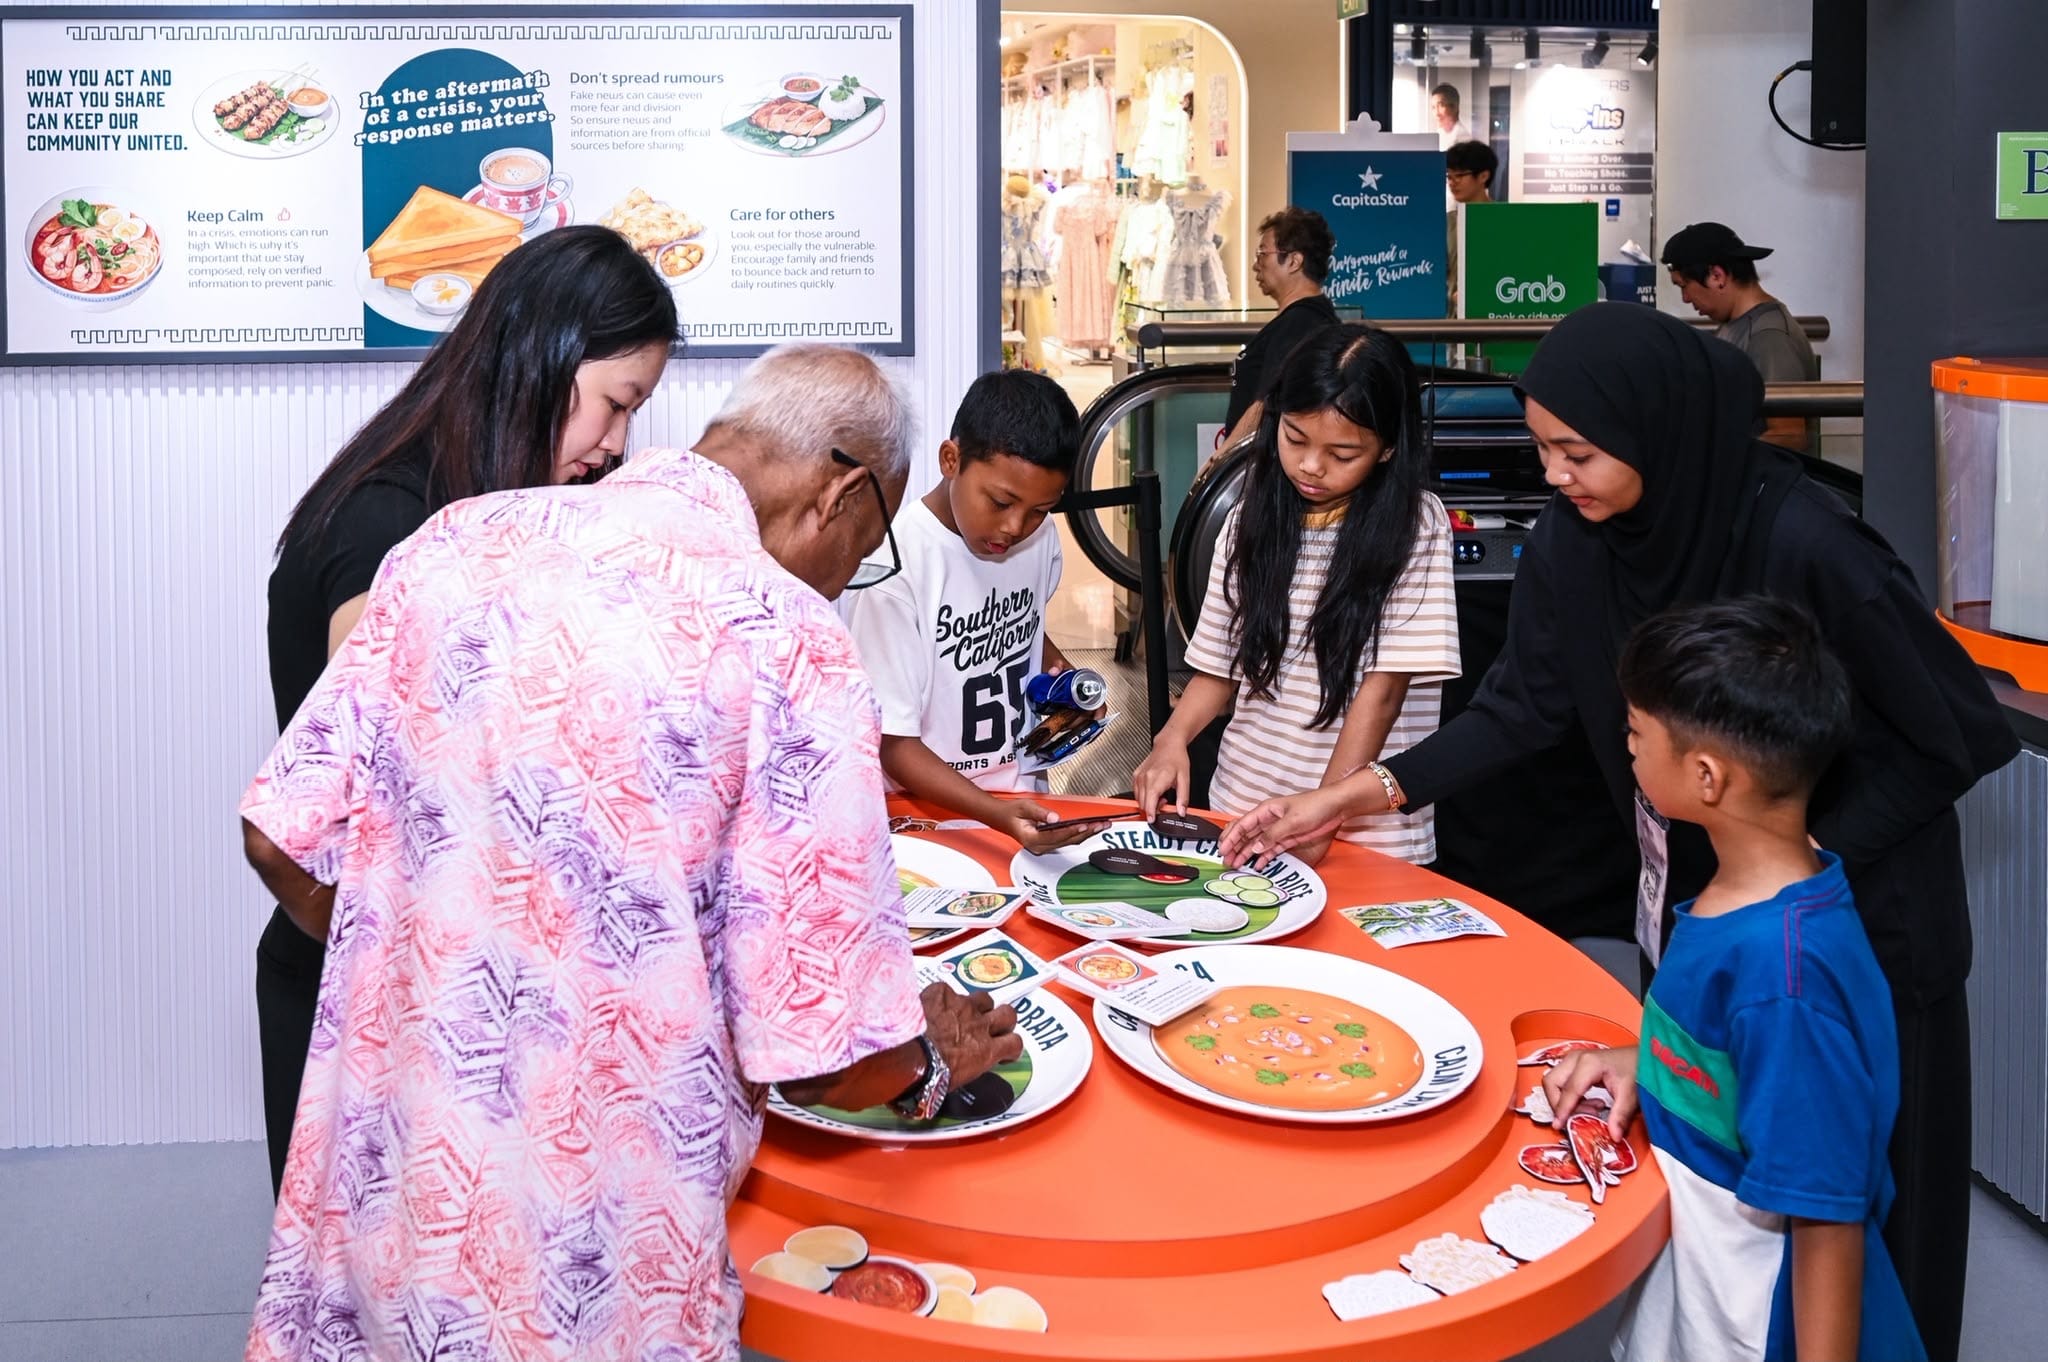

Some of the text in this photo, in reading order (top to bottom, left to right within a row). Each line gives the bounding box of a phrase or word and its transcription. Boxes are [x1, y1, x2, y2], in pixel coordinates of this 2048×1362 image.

[27, 70, 171, 86] HOW YOU ACT AND
[570, 72, 724, 86] Don't spread rumours
[360, 70, 550, 109] In the aftermath
[571, 91, 593, 99] Fake
[27, 91, 165, 107] WHAT YOU SHARE
[367, 92, 544, 125] of a crisis, your
[600, 103, 619, 111] fear
[622, 103, 640, 111] and
[27, 113, 138, 129] CAN KEEP OUR
[571, 116, 583, 124] So
[653, 116, 671, 124] and
[354, 110, 555, 146] response matters.
[571, 129, 629, 137] information
[651, 129, 675, 137] from
[678, 128, 710, 136] official
[27, 135, 188, 151] COMMUNITY UNITED.
[613, 141, 644, 150] before
[1332, 192, 1409, 210] CapitaStar
[188, 209, 263, 224] Keep Calm
[730, 208, 835, 220] Care for others
[731, 230, 755, 238] Look
[778, 230, 791, 238] for
[795, 230, 822, 238] those
[825, 229, 860, 238] around
[215, 241, 246, 249] Which
[260, 241, 281, 251] why
[755, 243, 802, 252] especially
[805, 242, 820, 250] the
[189, 254, 238, 264] important
[242, 254, 261, 262] that
[284, 254, 304, 264] stay
[731, 254, 873, 265] Encourage family and friends
[248, 266, 265, 276] rely
[284, 266, 321, 275] verified
[745, 268, 781, 276] bounce
[784, 267, 807, 276] back
[810, 267, 828, 275] and
[189, 279, 335, 289] information to prevent panic.
[731, 280, 753, 289] daily
[757, 280, 797, 288] routines
[1496, 274, 1566, 303] Grab
[936, 587, 1034, 642] Southern
[961, 656, 1031, 755] 65
[1102, 831, 1184, 851] STEADY
[1275, 871, 1313, 900] RICE
[1015, 997, 1069, 1051] PRATA
[1428, 1046, 1468, 1086] CALM
